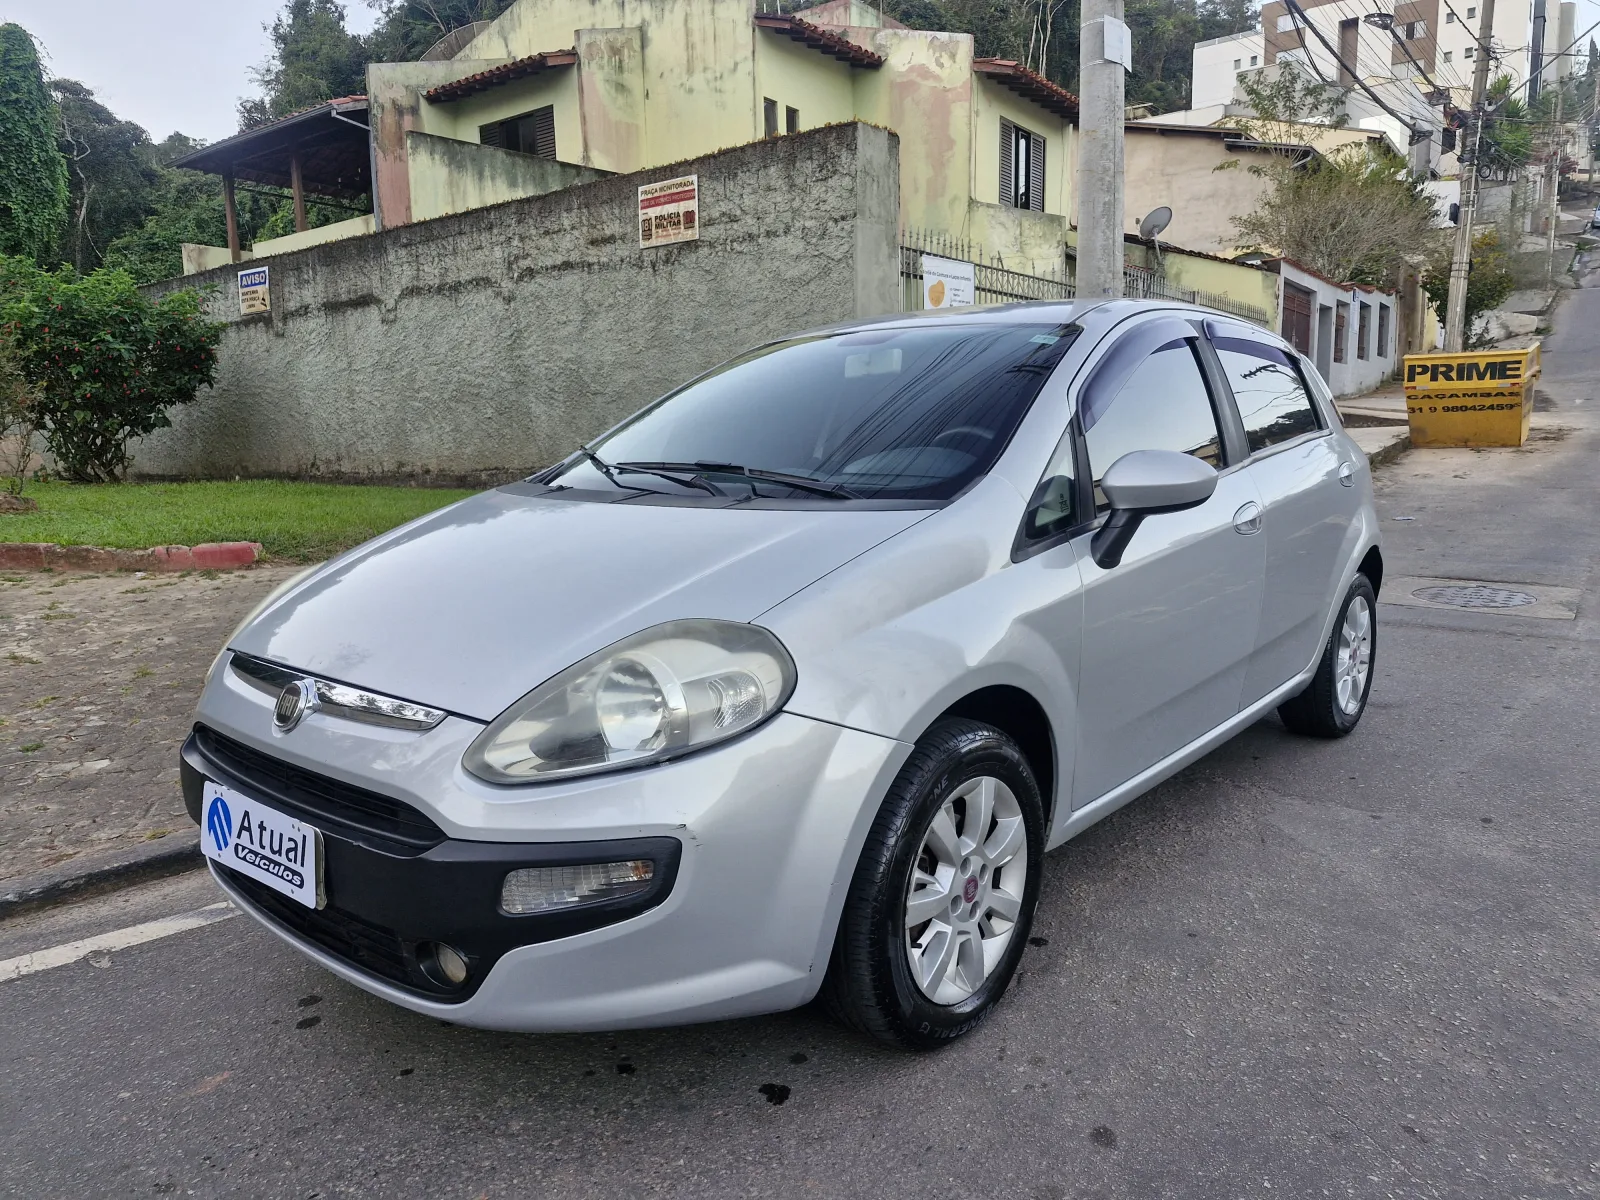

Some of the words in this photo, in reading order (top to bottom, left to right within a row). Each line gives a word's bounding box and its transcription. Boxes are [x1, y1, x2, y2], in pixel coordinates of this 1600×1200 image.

[640, 188, 658, 197] PRAÇA
[658, 180, 695, 193] MONITORADA
[654, 211, 681, 222] POLÍCIA
[641, 218, 652, 231] 181
[654, 219, 681, 230] MILITAR
[241, 272, 266, 286] AVISO
[1406, 360, 1523, 383] PRIME
[1406, 391, 1521, 401] CAÇAMBAS
[1408, 406, 1423, 414] 31
[236, 810, 307, 868] Atual
[238, 845, 301, 886] Veículos
